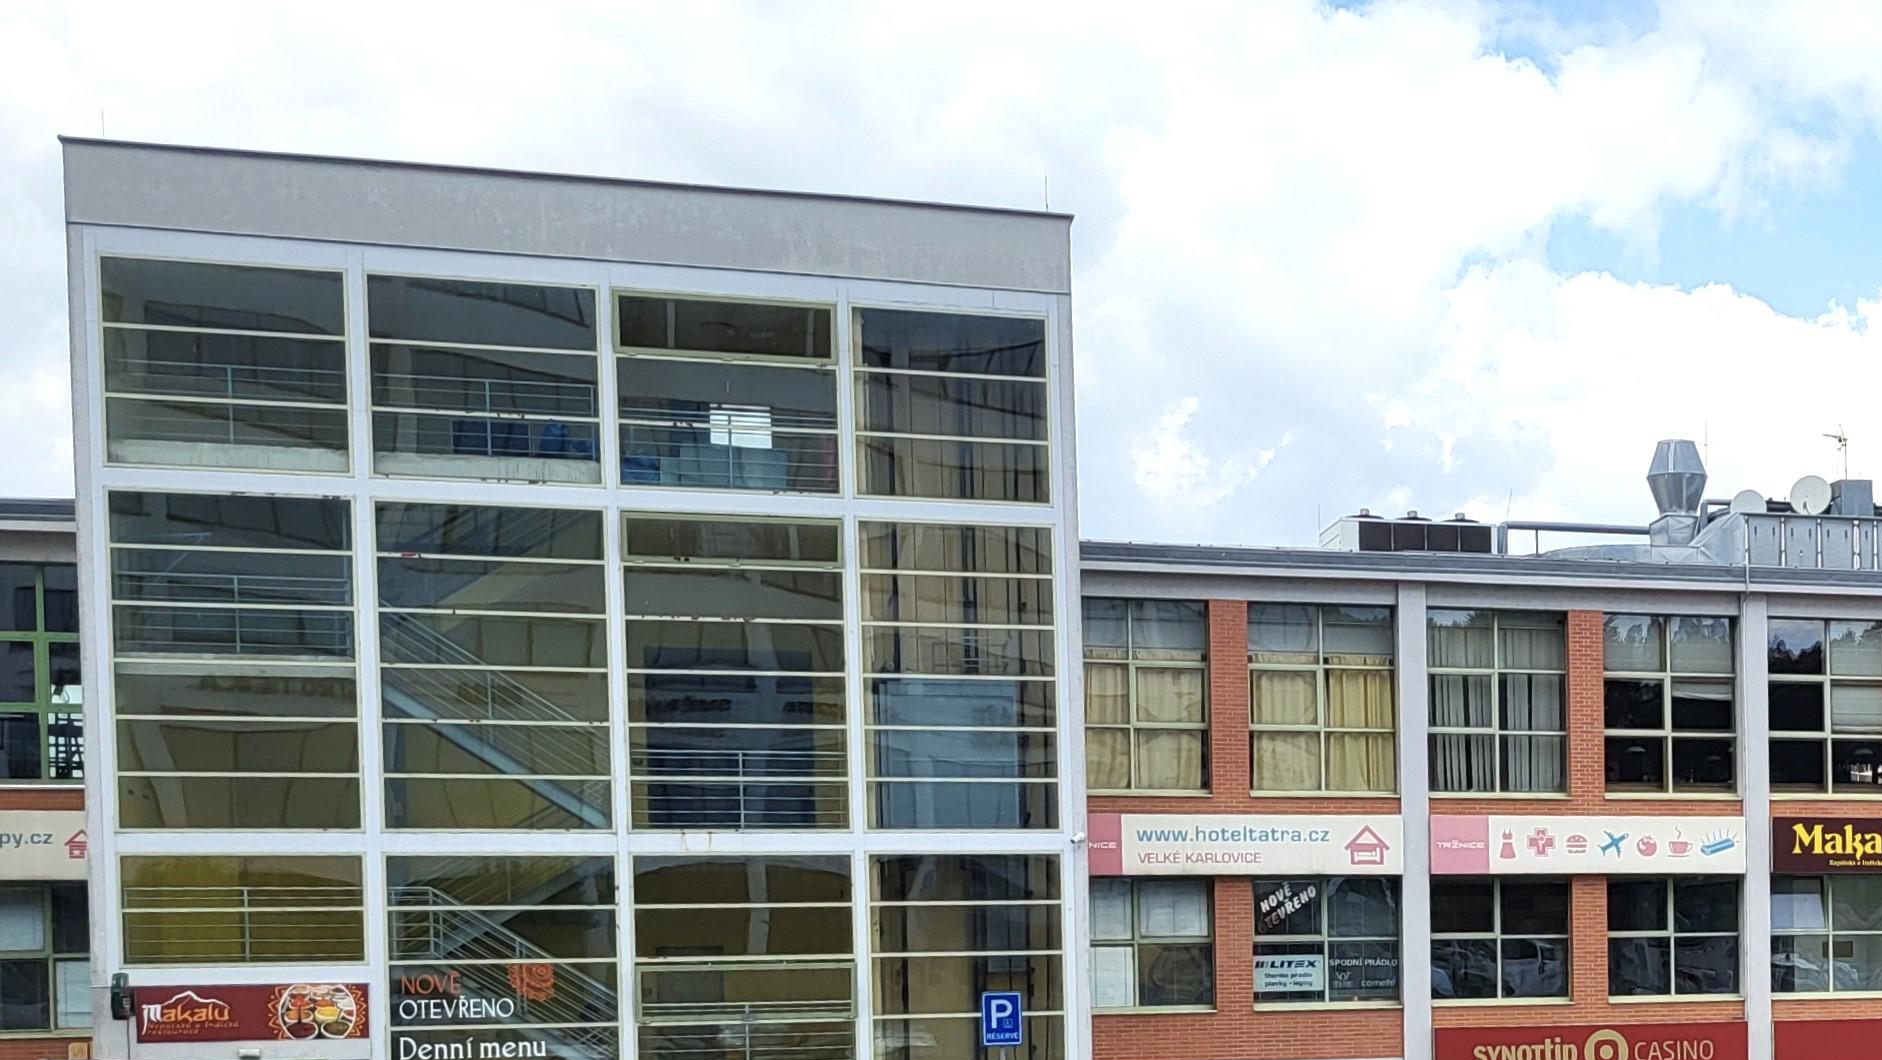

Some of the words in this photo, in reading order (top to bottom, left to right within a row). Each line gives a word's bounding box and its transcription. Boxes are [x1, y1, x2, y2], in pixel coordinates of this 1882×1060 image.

[0, 833, 54, 849] py.cz
[1136, 826, 1330, 842] www.hoteltatra.cz
[1436, 839, 1485, 849] TRŽNICE
[1138, 850, 1180, 864] VELKÉ
[1186, 852, 1262, 864] KARLOVICE
[1270, 960, 1318, 969] LITEX
[1329, 957, 1362, 966] SPODNÍ
[1364, 957, 1398, 966] PRÁDLO
[400, 995, 514, 1019] OTEVŘENO
[991, 1000, 1012, 1028] P
[400, 1037, 472, 1060] Denní
[480, 1041, 547, 1058] menu
